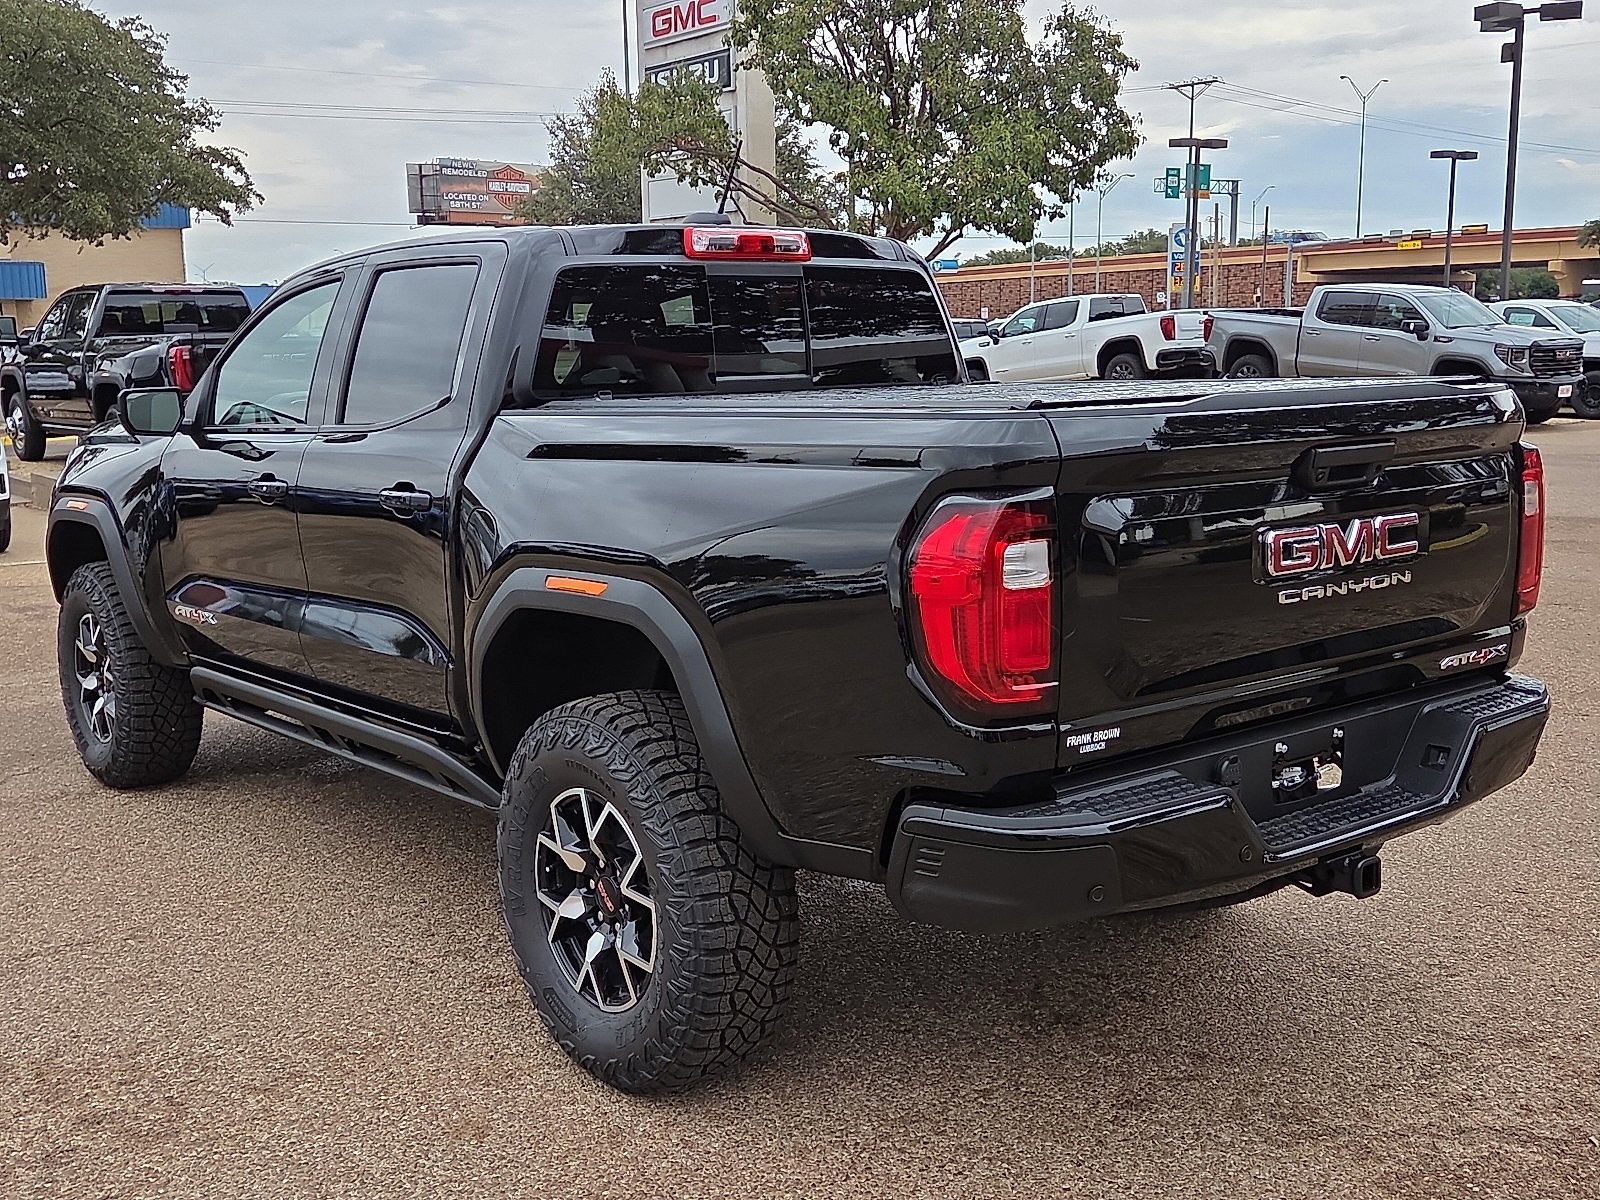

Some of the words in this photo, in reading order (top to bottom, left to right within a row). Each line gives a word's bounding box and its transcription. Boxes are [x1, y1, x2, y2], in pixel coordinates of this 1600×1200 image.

[651, 0, 717, 38] GMC
[441, 167, 488, 178] REMODELED
[452, 161, 477, 169] NEWLY
[443, 192, 477, 201] LOCATED
[478, 194, 489, 202] ON
[471, 202, 483, 210] ST.
[1266, 512, 1420, 577] GMC
[1278, 570, 1413, 605] CANYON
[174, 605, 218, 625] AT4X
[1439, 643, 1508, 670] AT4X
[1066, 732, 1093, 748] FRANK
[1093, 727, 1121, 742] BROWN
[1079, 741, 1106, 754] LUBBOCK
